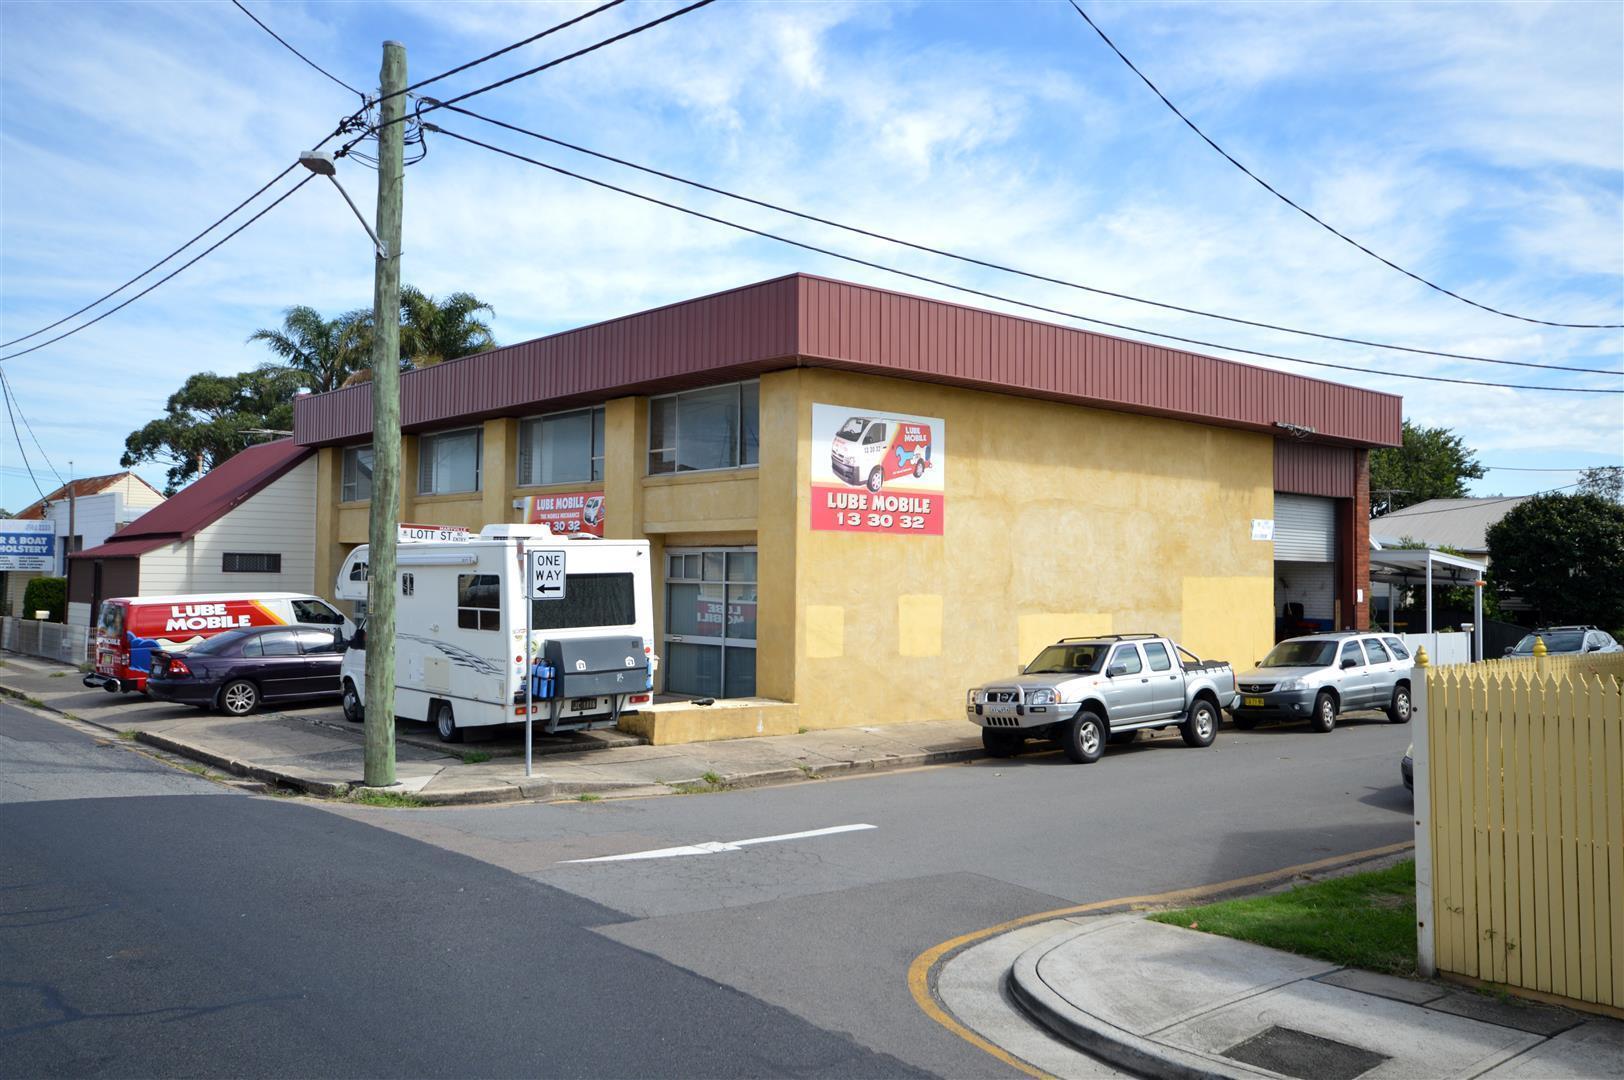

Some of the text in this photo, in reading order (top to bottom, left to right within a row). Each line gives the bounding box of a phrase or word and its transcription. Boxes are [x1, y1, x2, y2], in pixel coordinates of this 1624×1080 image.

[536, 496, 584, 511] LUBE MOBILE
[827, 492, 931, 514] LUBE MOBILE
[553, 520, 566, 531] 30
[567, 520, 581, 531] 32
[837, 512, 925, 529] 13 30 32
[19, 536, 48, 545] BOAT
[410, 529, 453, 541] LOTT ST
[537, 555, 560, 566] ONE
[535, 570, 562, 581] WAY
[171, 603, 227, 618] LUBE
[165, 615, 252, 632] MOBILE
